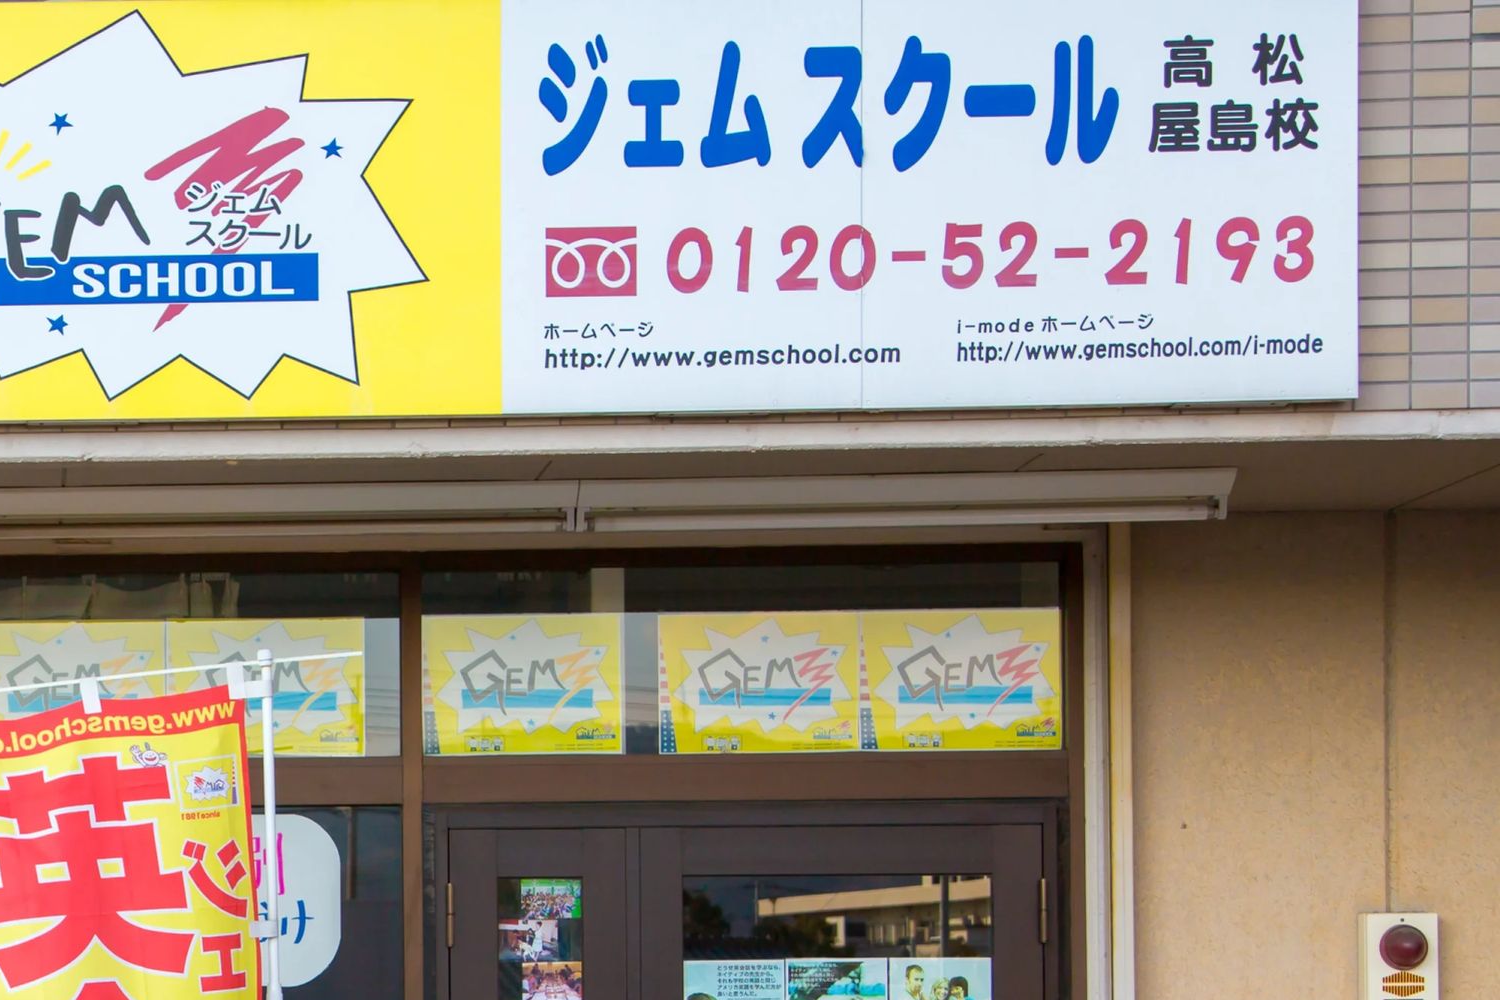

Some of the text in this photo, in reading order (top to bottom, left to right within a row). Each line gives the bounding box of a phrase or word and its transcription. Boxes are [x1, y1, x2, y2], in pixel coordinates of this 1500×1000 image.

[1162, 32, 1305, 90] 高松
[538, 33, 1120, 176] ジェムスクール
[1148, 98, 1320, 154] 屋島校
[185, 182, 282, 216] ジェム
[186, 220, 313, 250] スクール
[666, 215, 1315, 294] 0120-52-2193
[72, 259, 295, 299] SCHOOL
[543, 321, 655, 339] ホームページ
[956, 313, 1155, 335] i-mode ホームページ
[956, 332, 1325, 363] http://www.gemschool.com/i-mode
[543, 341, 902, 371] http://www.gemschool.com
[460, 649, 563, 717] GEM
[698, 647, 802, 711] GEM
[897, 645, 999, 711] GEM
